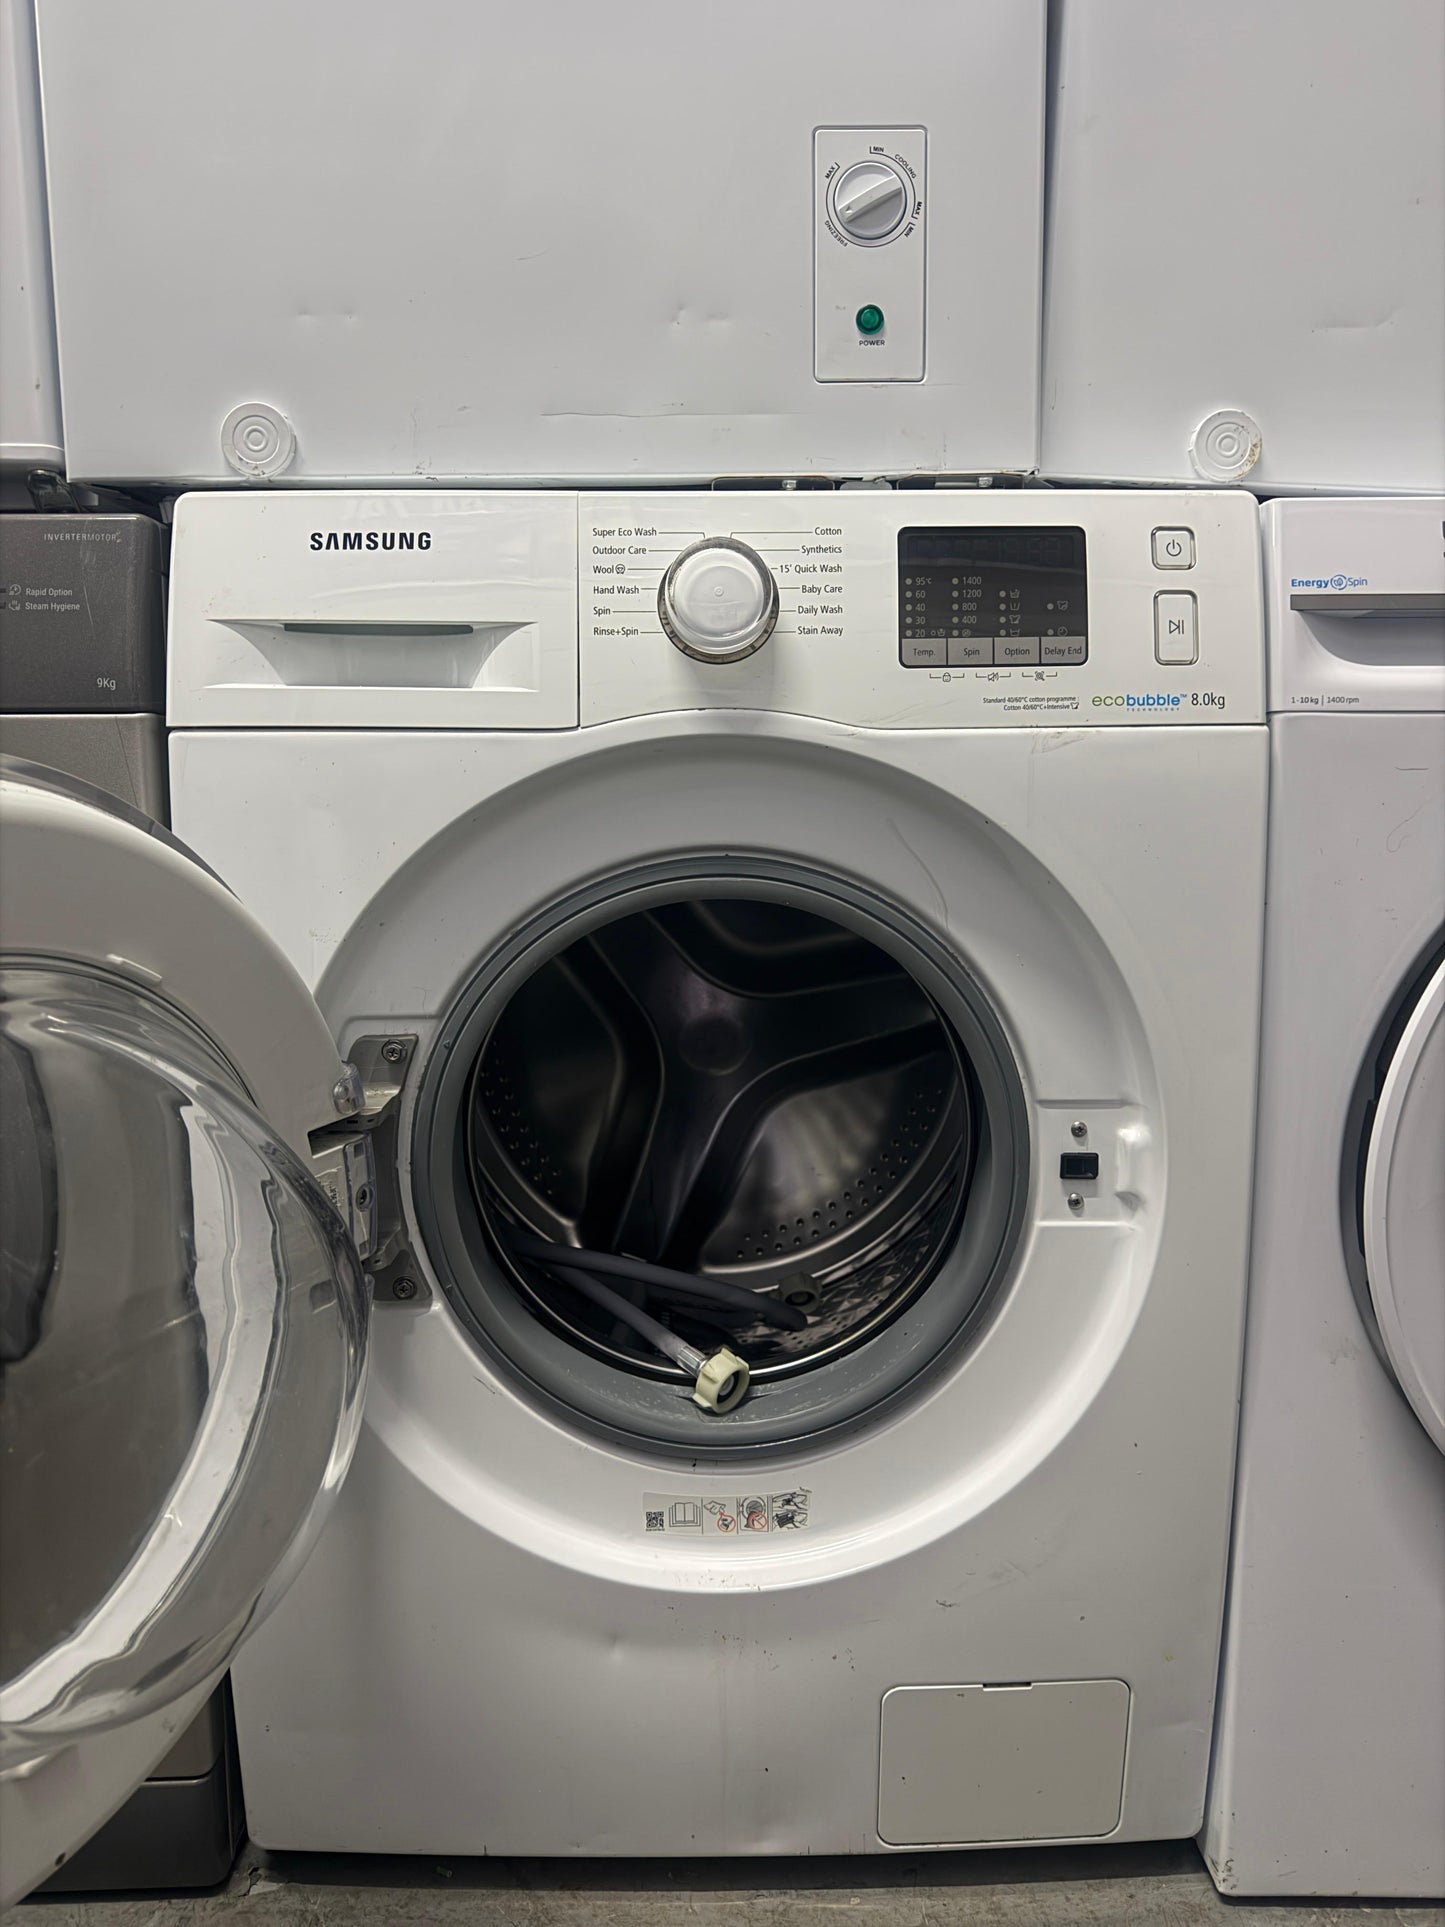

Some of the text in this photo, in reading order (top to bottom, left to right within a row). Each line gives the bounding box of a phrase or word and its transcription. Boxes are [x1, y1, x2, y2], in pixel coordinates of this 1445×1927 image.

[894, 154, 917, 179] COOLING
[825, 166, 836, 180] MAX
[824, 220, 848, 247] FREEZING
[904, 226, 914, 238] MIN
[592, 527, 657, 539] Super Eco Wash
[814, 526, 842, 536] Cotton
[310, 532, 431, 550] SAMSUNG
[592, 545, 647, 555] Outdoor Care
[801, 544, 843, 556] Synthetics
[593, 565, 614, 574] Wool
[794, 564, 817, 574] Quick
[820, 564, 843, 573] Wash
[962, 576, 982, 585] 1400
[1291, 577, 1368, 589] Energy Spin
[25, 587, 73, 597] Rapid Option
[593, 585, 640, 594] Hand Wash
[801, 584, 843, 595] Baby Care
[915, 590, 926, 599] 60
[962, 589, 982, 598] 1200
[25, 602, 80, 612] Steam Hygiene
[593, 606, 611, 617] Spin
[797, 605, 843, 616] Daily Wash
[915, 603, 926, 611] 40
[962, 602, 977, 611] 800
[915, 616, 926, 625] 30
[962, 615, 977, 624] 400
[593, 626, 639, 637] Rinse+Spin
[797, 626, 843, 636] Stain Away
[915, 629, 926, 637] 20
[913, 648, 936, 657] Temp.
[963, 647, 980, 658] Spin
[1004, 647, 1030, 657] Option
[1044, 646, 1082, 656] Delay End
[97, 677, 116, 690] 9Kg
[1191, 692, 1225, 709] 8.0kg
[1327, 696, 1345, 704] 1400
[1345, 697, 1360, 705] rpm
